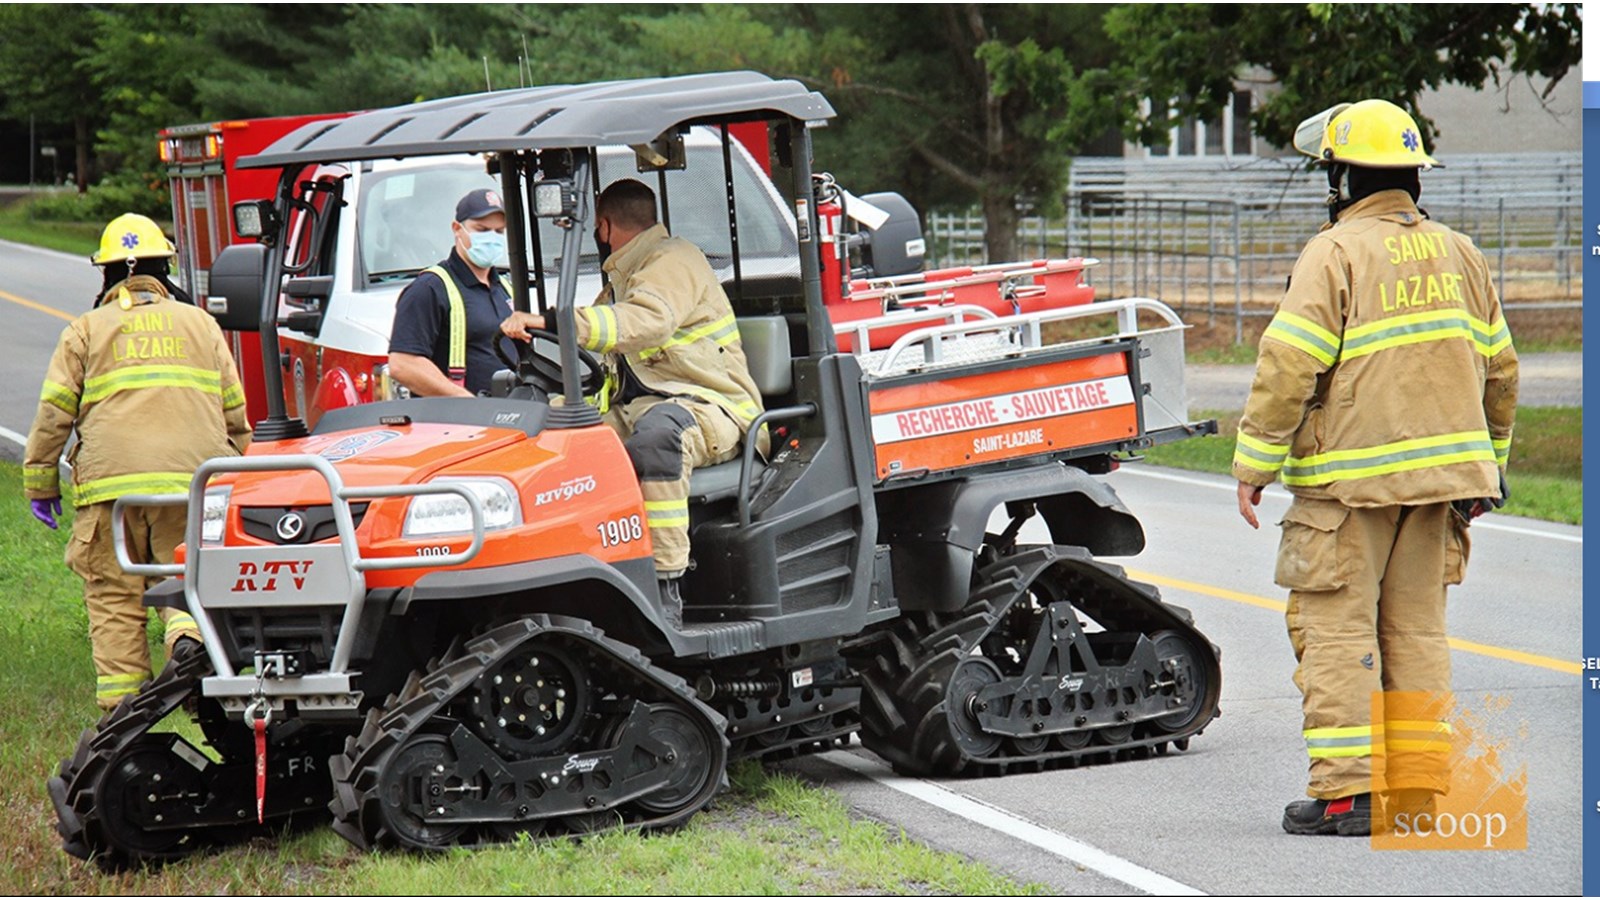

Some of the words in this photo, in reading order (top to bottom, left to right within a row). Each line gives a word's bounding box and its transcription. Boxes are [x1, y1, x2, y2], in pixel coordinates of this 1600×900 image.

[1383, 232, 1448, 265] SAINT
[1379, 272, 1464, 312] LAZARE
[119, 312, 173, 333] SAINT
[112, 335, 188, 361] LAZARE
[897, 401, 997, 436] RECHERCHE
[1014, 382, 1110, 419] SAUVETAGE
[973, 428, 1044, 454] SAINT-LAZARE
[534, 479, 597, 506] RTV900
[597, 514, 643, 548] 1908
[230, 560, 314, 592] RTV
